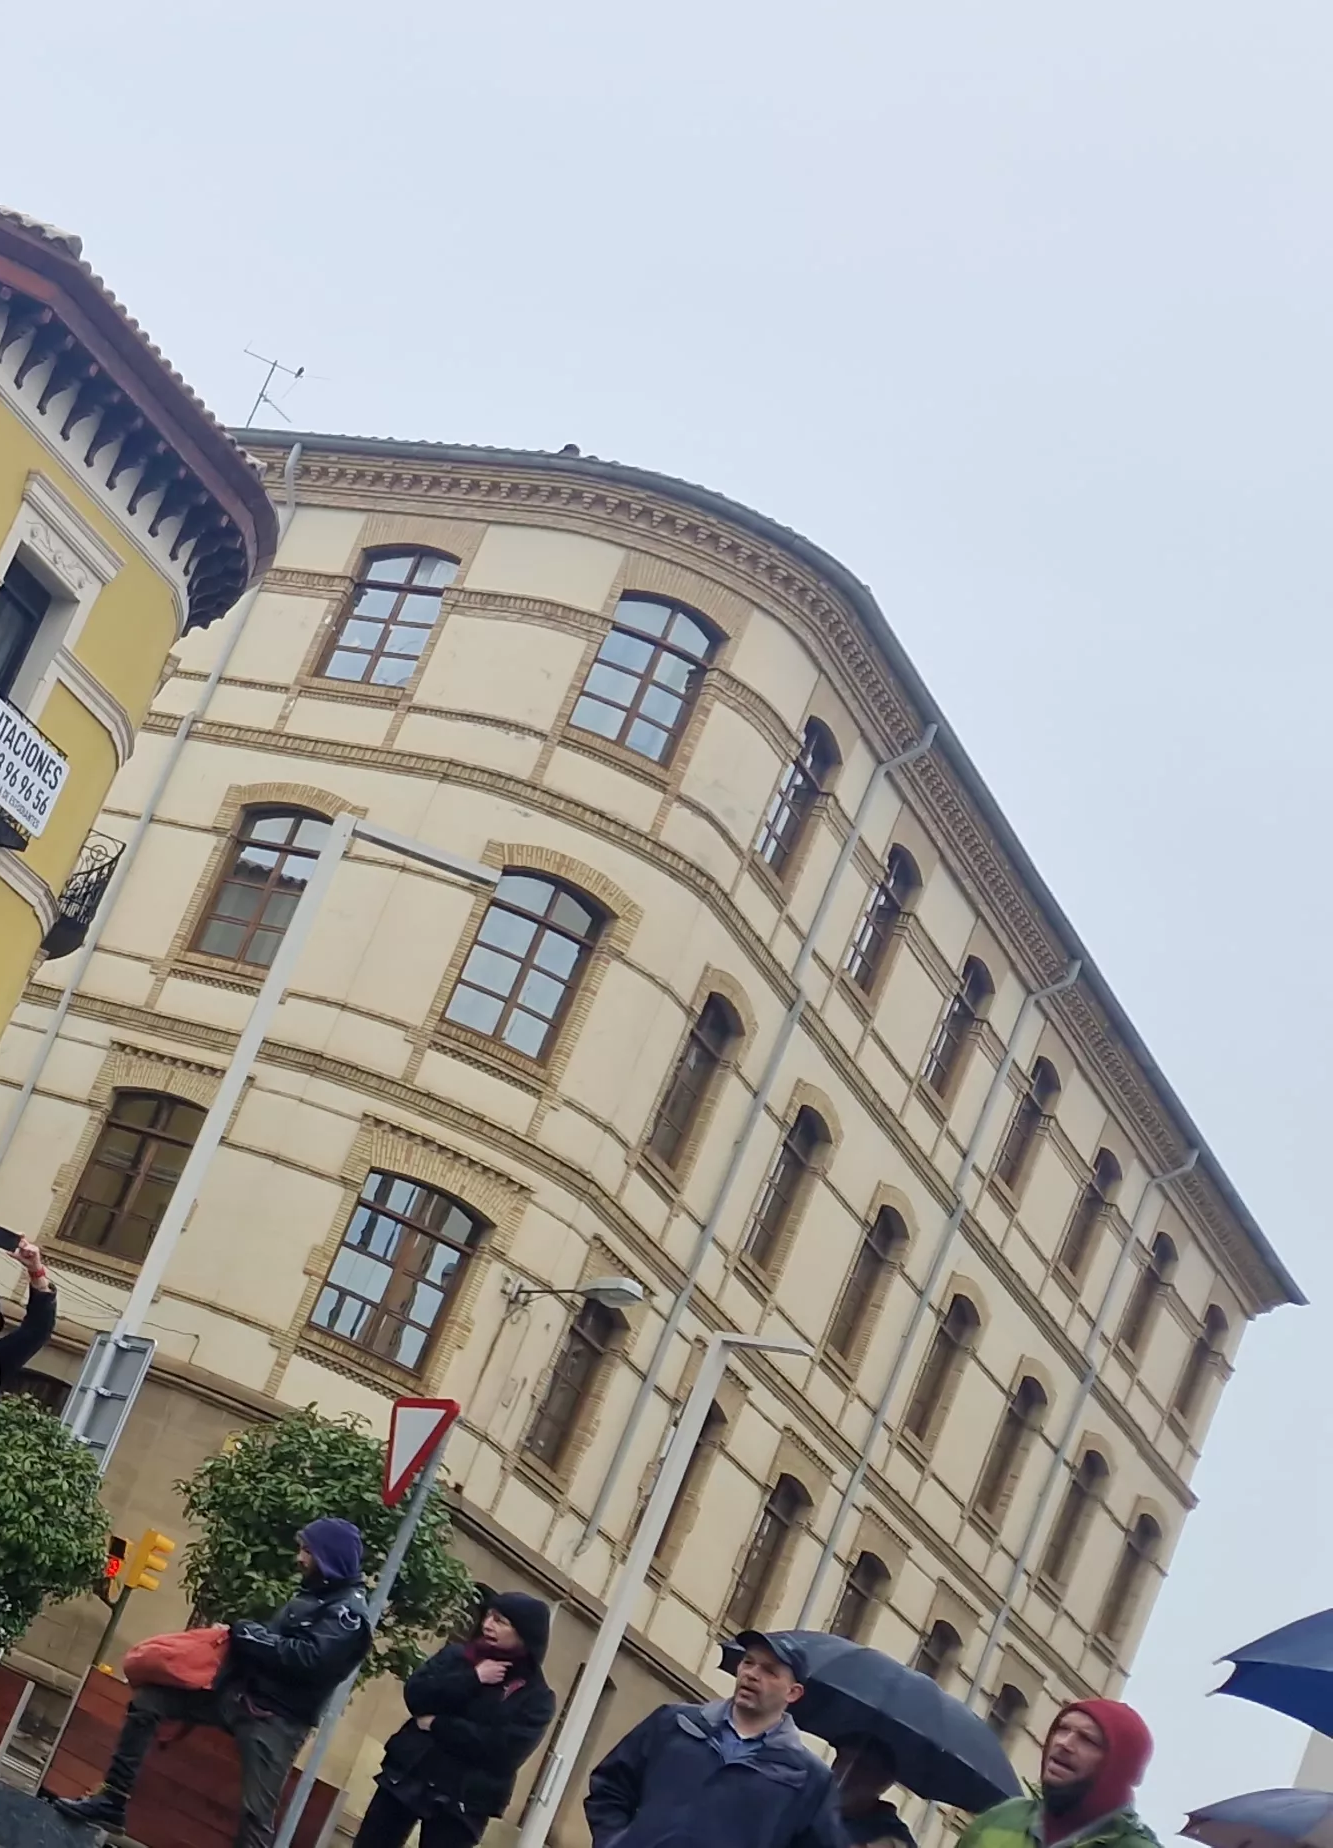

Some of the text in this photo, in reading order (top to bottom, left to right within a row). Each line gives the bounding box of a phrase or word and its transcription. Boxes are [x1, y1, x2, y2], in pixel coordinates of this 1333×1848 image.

[2, 761, 20, 788] 96
[17, 776, 35, 802] 96
[32, 788, 50, 816] 56
